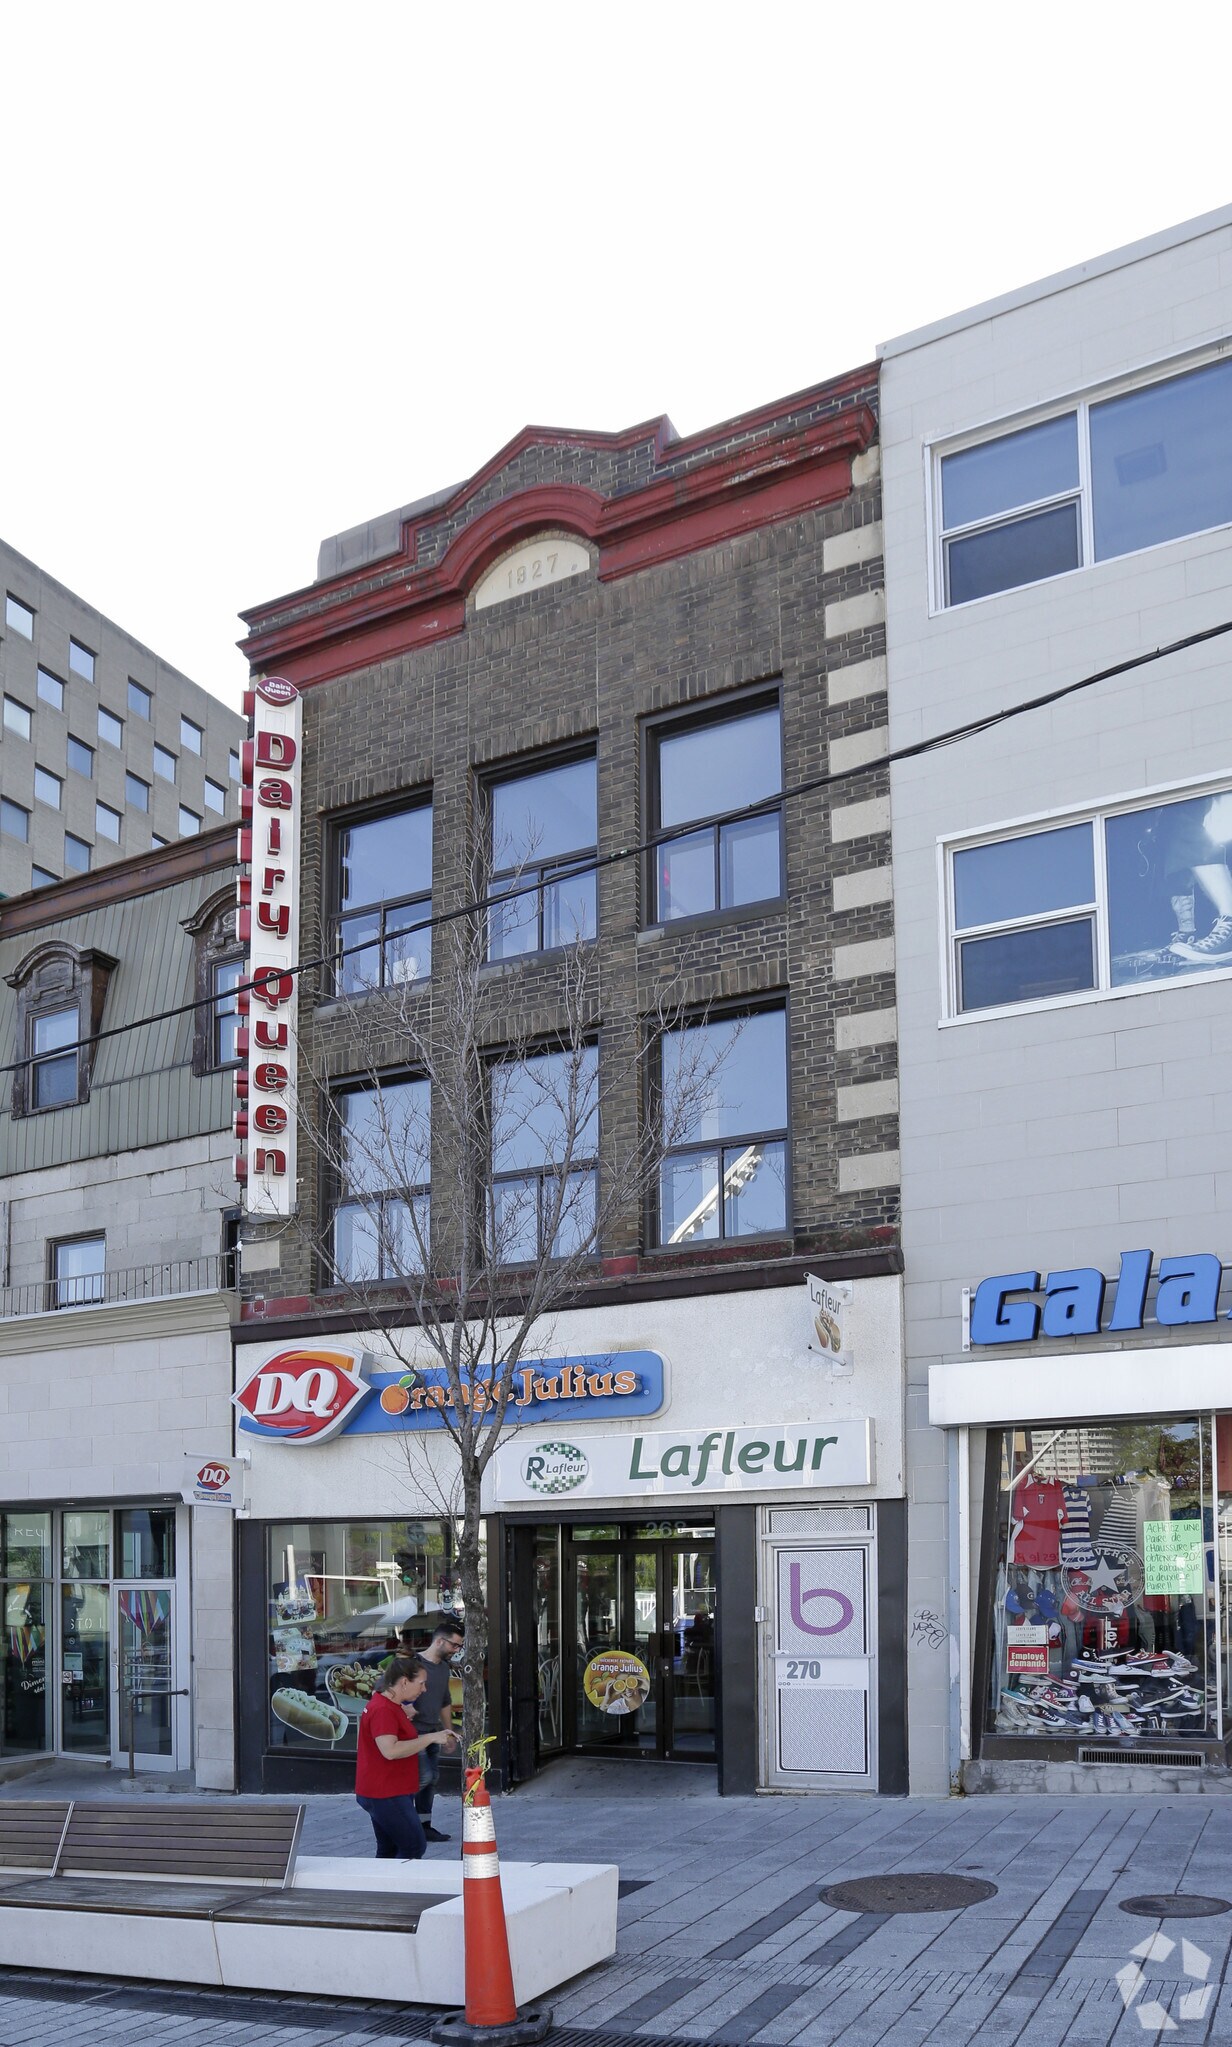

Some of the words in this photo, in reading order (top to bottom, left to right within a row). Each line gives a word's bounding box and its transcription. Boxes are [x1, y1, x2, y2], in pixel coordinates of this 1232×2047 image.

[264, 686, 291, 696] Queen
[269, 682, 291, 691] Dairy
[255, 731, 297, 940] Dairy
[252, 966, 294, 1176] Queen
[810, 1283, 841, 1315] Lafleur
[969, 1248, 1232, 1345] Gala
[253, 1368, 339, 1418] DQ
[380, 1376, 514, 1415] Orange
[515, 1364, 637, 1406] Julius
[546, 1463, 585, 1475] Lafleur
[628, 1432, 838, 1487] Lafleur
[202, 1468, 226, 1486] DQ
[1071, 1548, 1135, 1570] COVERSE
[1011, 1652, 1045, 1660] Employé
[591, 1662, 619, 1673] Orange
[620, 1664, 643, 1673] Julius
[786, 1660, 821, 1680] 270
